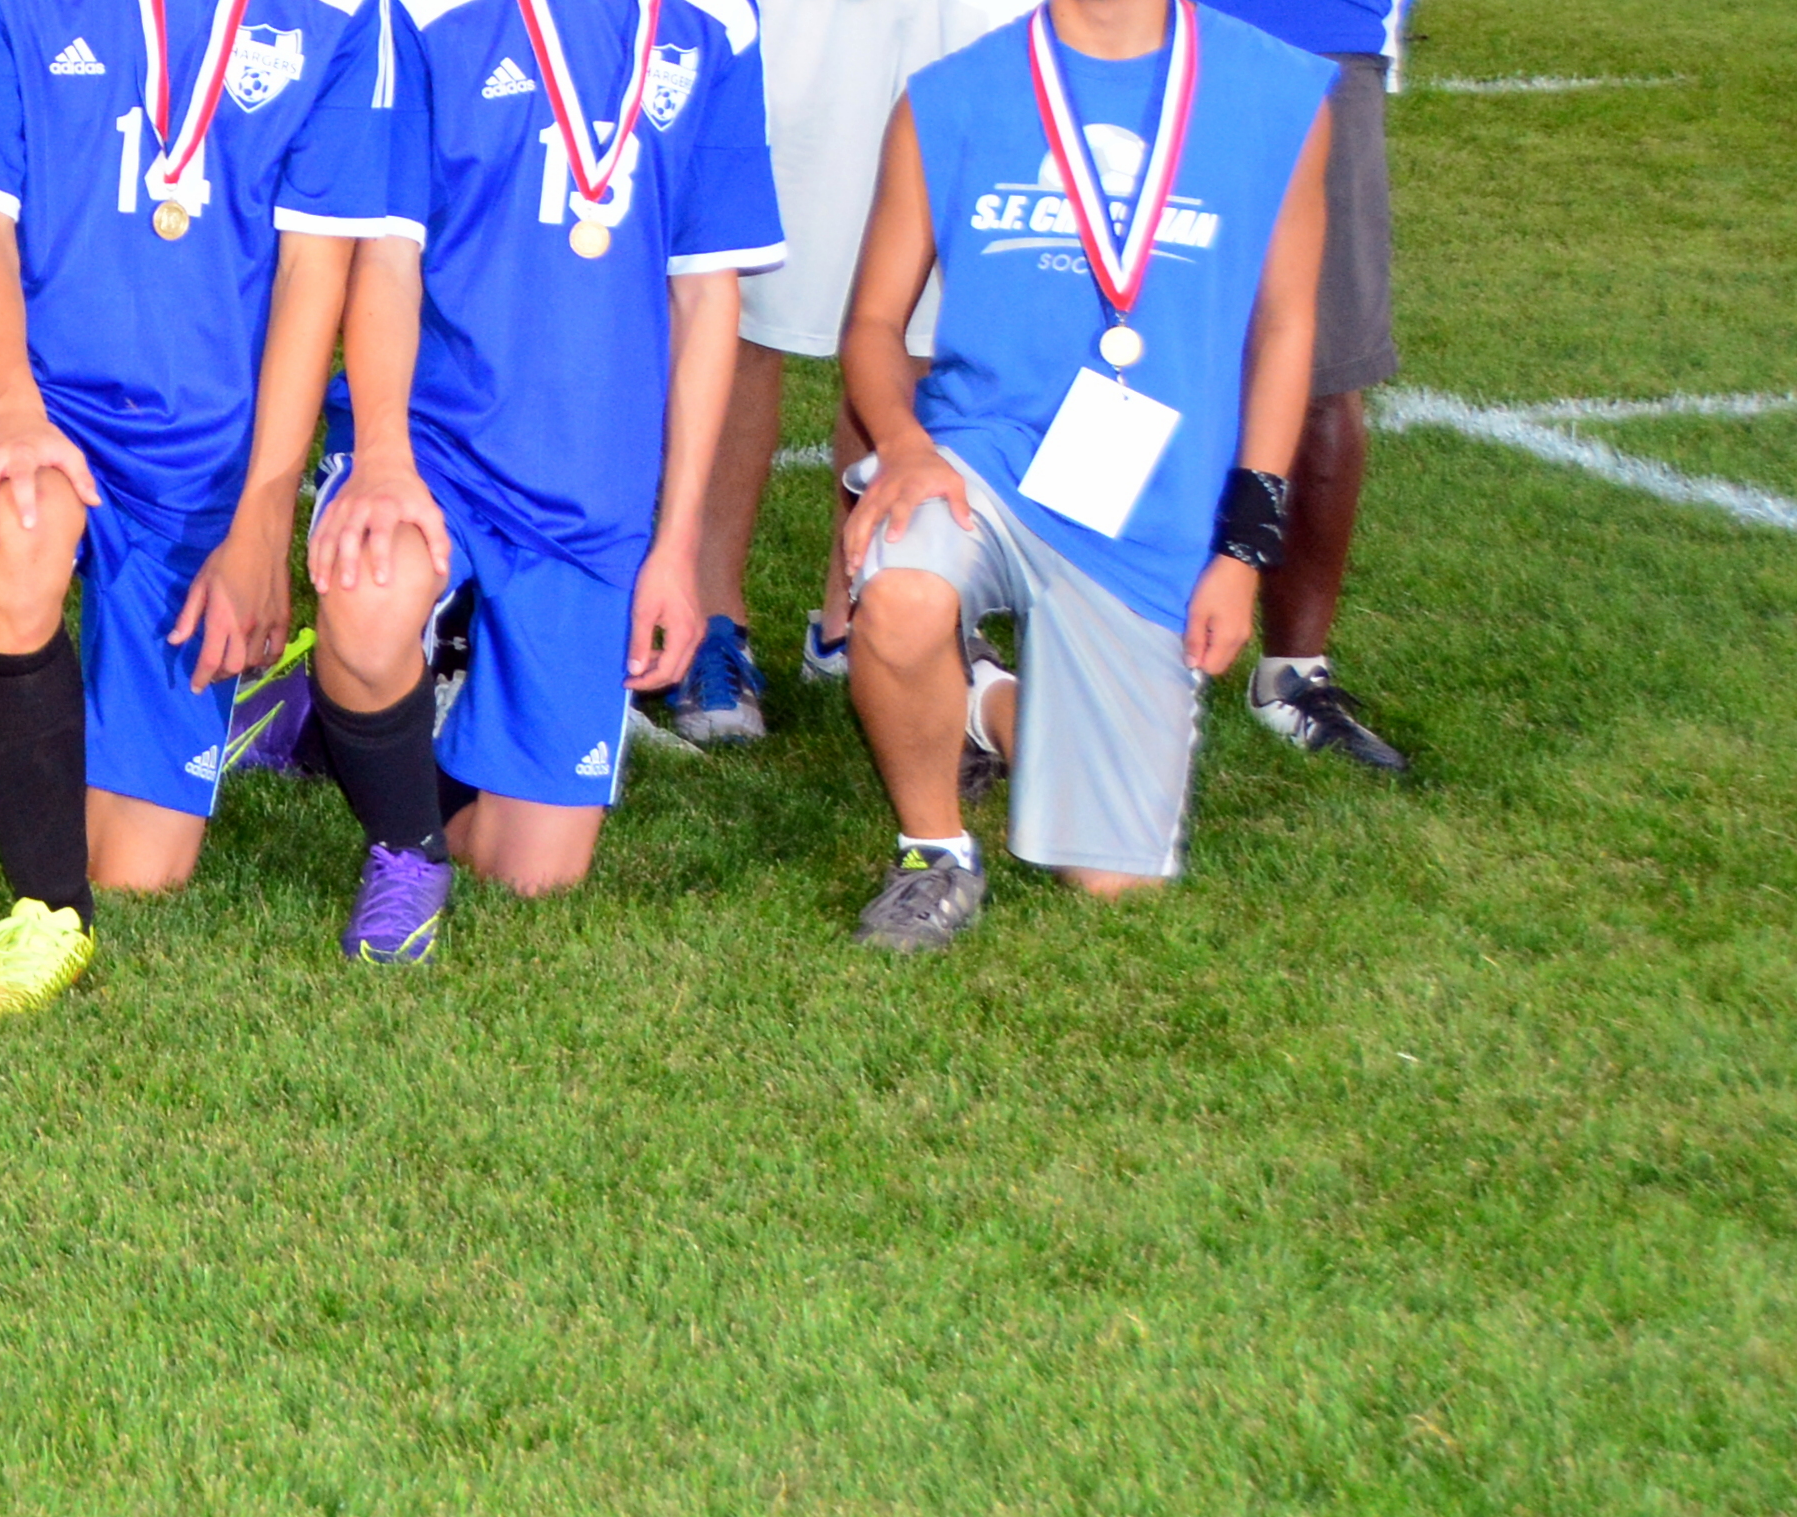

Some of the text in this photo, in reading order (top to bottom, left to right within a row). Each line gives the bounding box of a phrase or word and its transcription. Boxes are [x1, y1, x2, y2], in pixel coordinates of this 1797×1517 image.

[49, 59, 106, 75] adidas
[231, 46, 298, 76] HARGERS
[481, 78, 536, 100] adidas
[645, 66, 697, 88] HARGERS
[116, 107, 211, 218] 14
[970, 193, 1027, 231] S.F.
